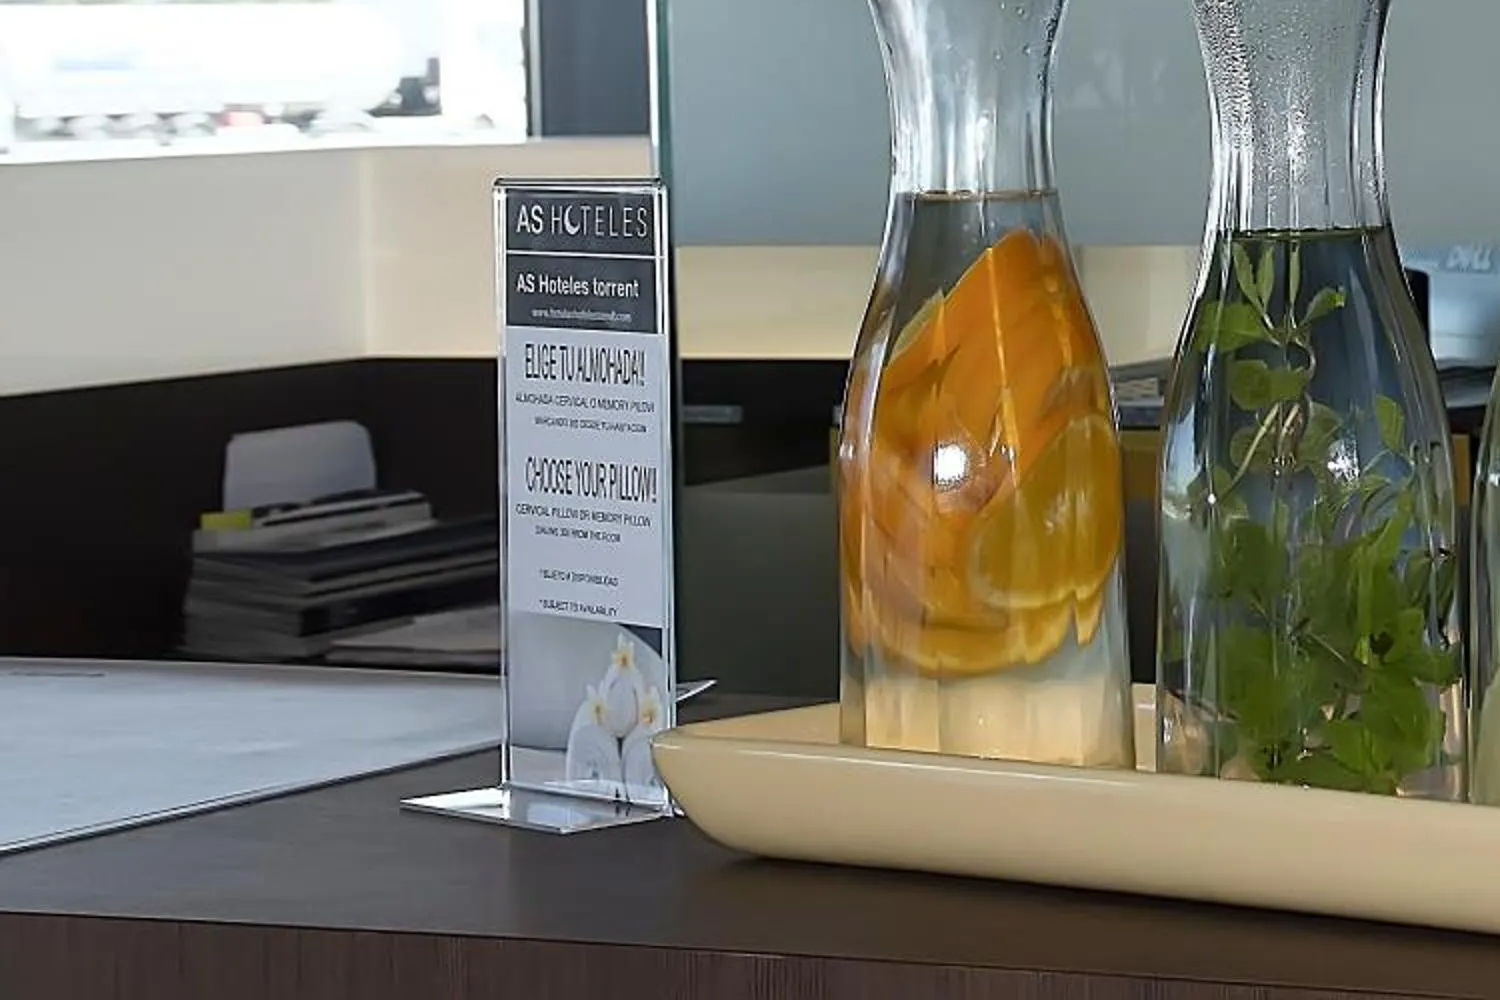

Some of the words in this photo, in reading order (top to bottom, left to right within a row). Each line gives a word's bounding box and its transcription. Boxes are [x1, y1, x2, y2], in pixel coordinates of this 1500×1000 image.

[515, 204, 544, 235] AS
[516, 273, 536, 294] AS
[539, 274, 590, 296] Hoteles
[593, 276, 640, 299] torrent
[525, 343, 557, 379] ELIGE
[559, 345, 575, 382] TU
[525, 456, 573, 495] CHOOSE
[574, 460, 607, 499] YOUR
